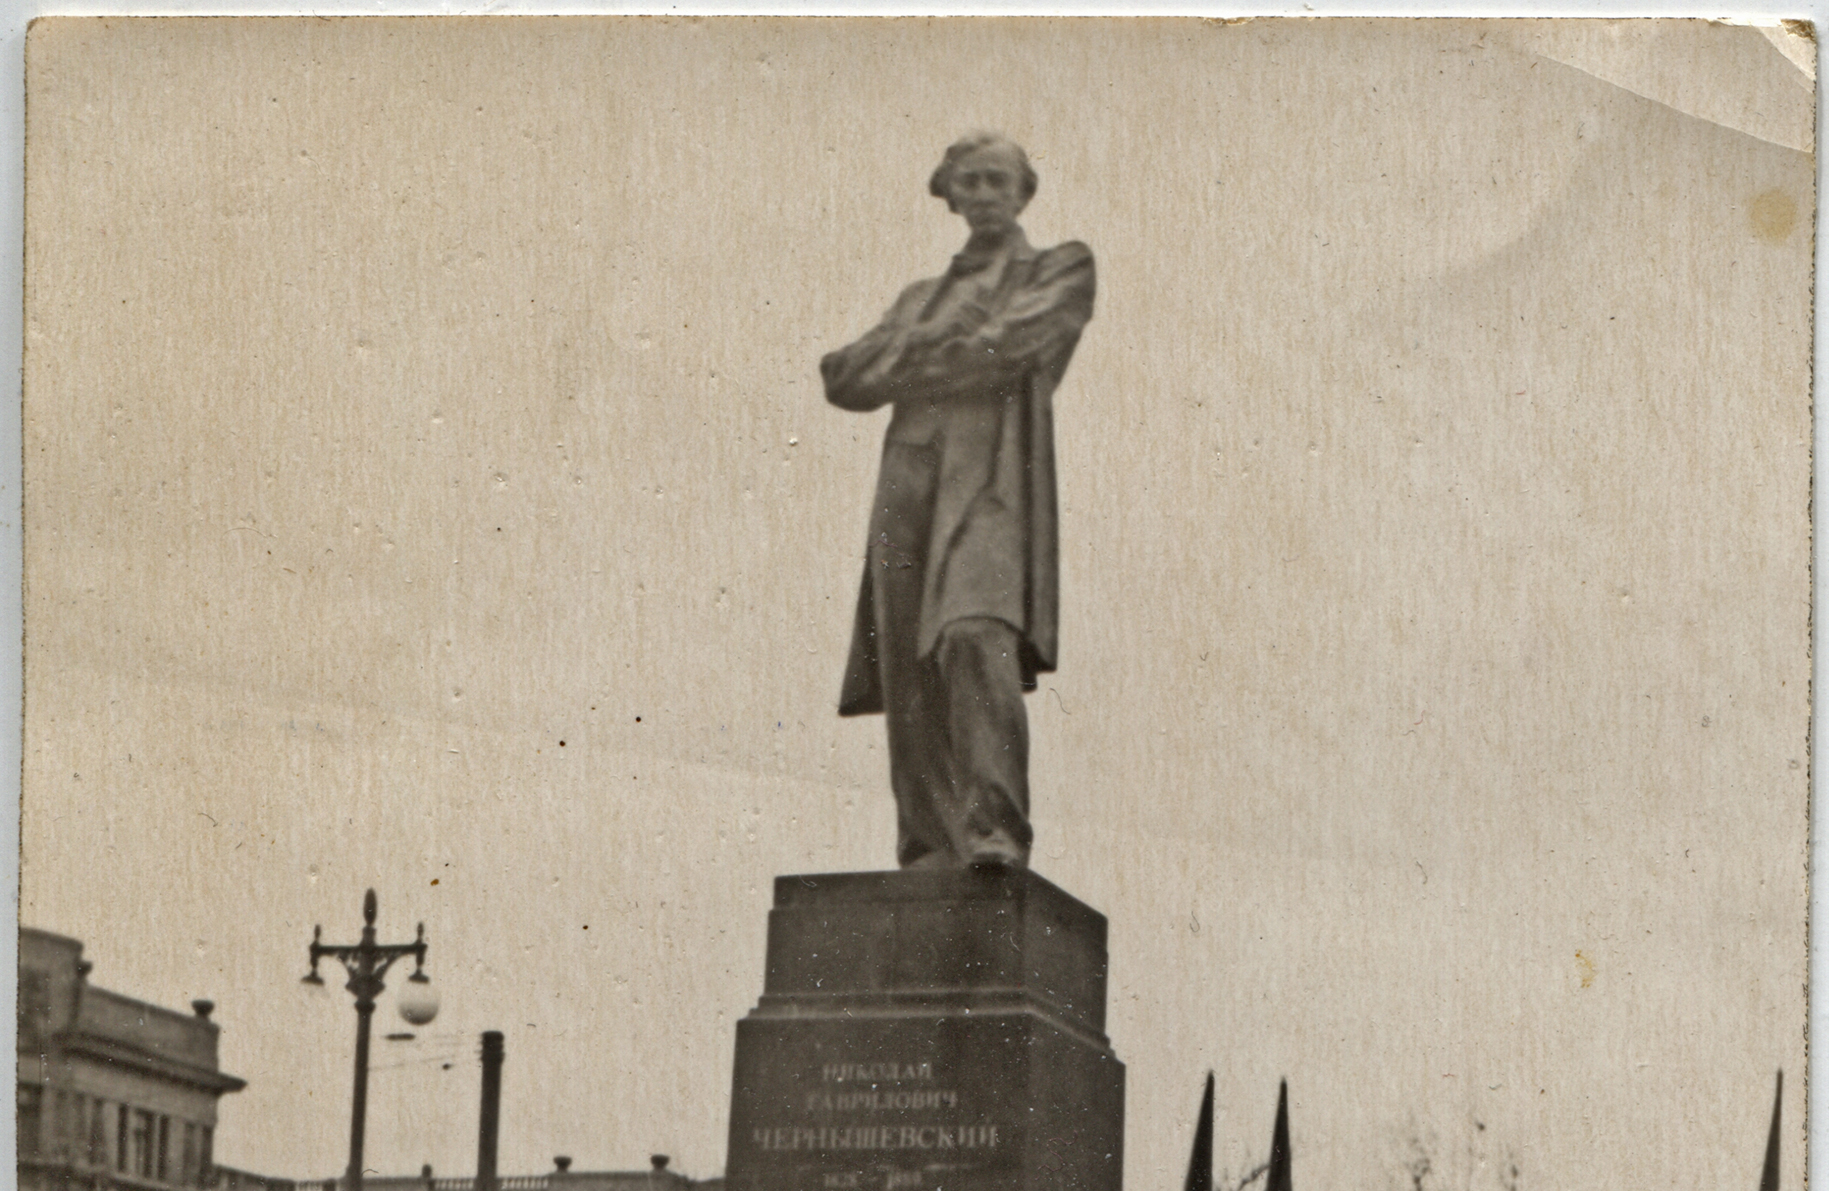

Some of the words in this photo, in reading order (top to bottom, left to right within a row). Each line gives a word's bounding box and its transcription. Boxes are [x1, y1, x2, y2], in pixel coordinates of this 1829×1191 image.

[823, 1063, 932, 1081] НИКОЛАЙ
[806, 1090, 957, 1109] ГАВРИЛОВИЧ
[753, 1125, 997, 1149] ЧЕРНЫШЕВСКИЙ
